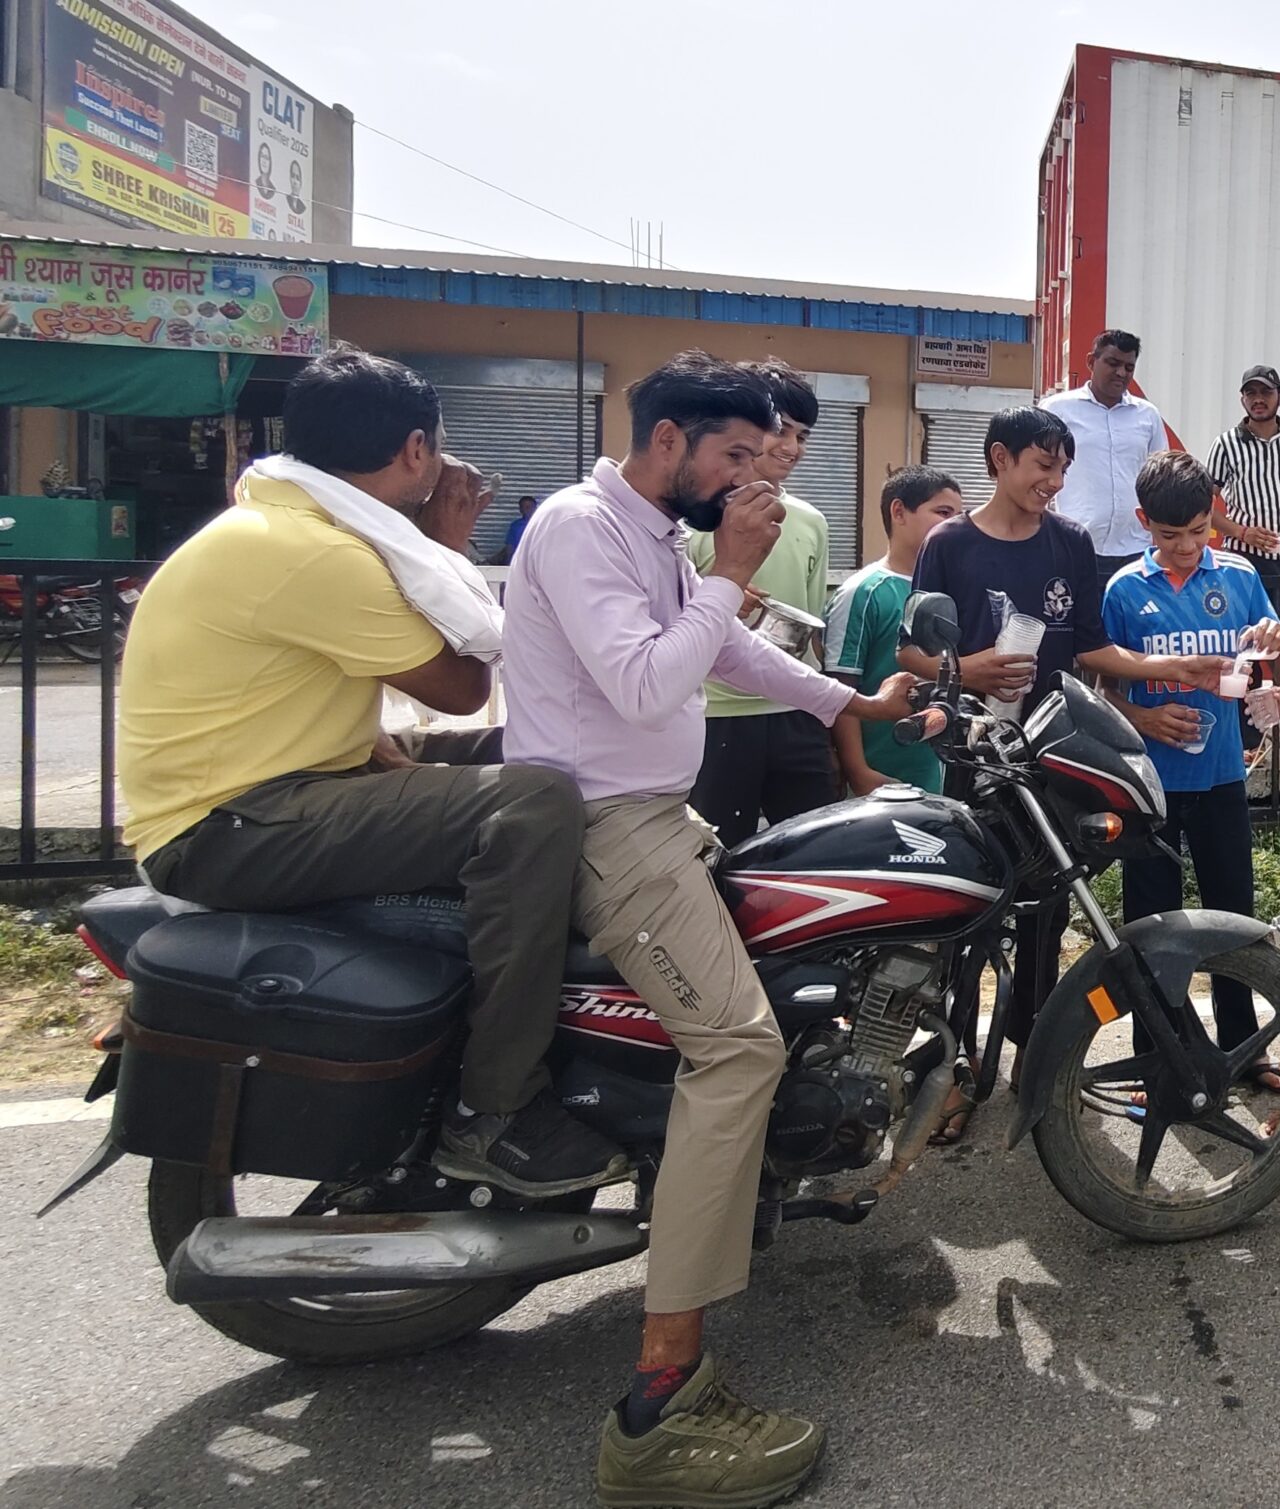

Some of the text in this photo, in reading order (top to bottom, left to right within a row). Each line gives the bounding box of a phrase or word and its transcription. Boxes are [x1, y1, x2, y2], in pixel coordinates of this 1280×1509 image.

[148, 43, 186, 78] OPEN
[262, 81, 306, 134] CLAT
[87, 120, 128, 149] ENROLL
[257, 117, 309, 158] Qualifier 2025
[92, 159, 143, 198] SHREE
[148, 183, 209, 226] KRISHAN
[218, 215, 235, 237] 25
[24, 256, 83, 286] श्याम
[89, 261, 136, 303] जूस
[85, 291, 97, 301] &
[32, 308, 166, 344] Food
[61, 301, 135, 322] Fast
[1141, 628, 1237, 656] DREAM11
[887, 854, 947, 865] HONDA
[374, 894, 411, 907] BRS
[649, 947, 692, 1000] SPEED
[776, 1122, 826, 1136] HONDA
